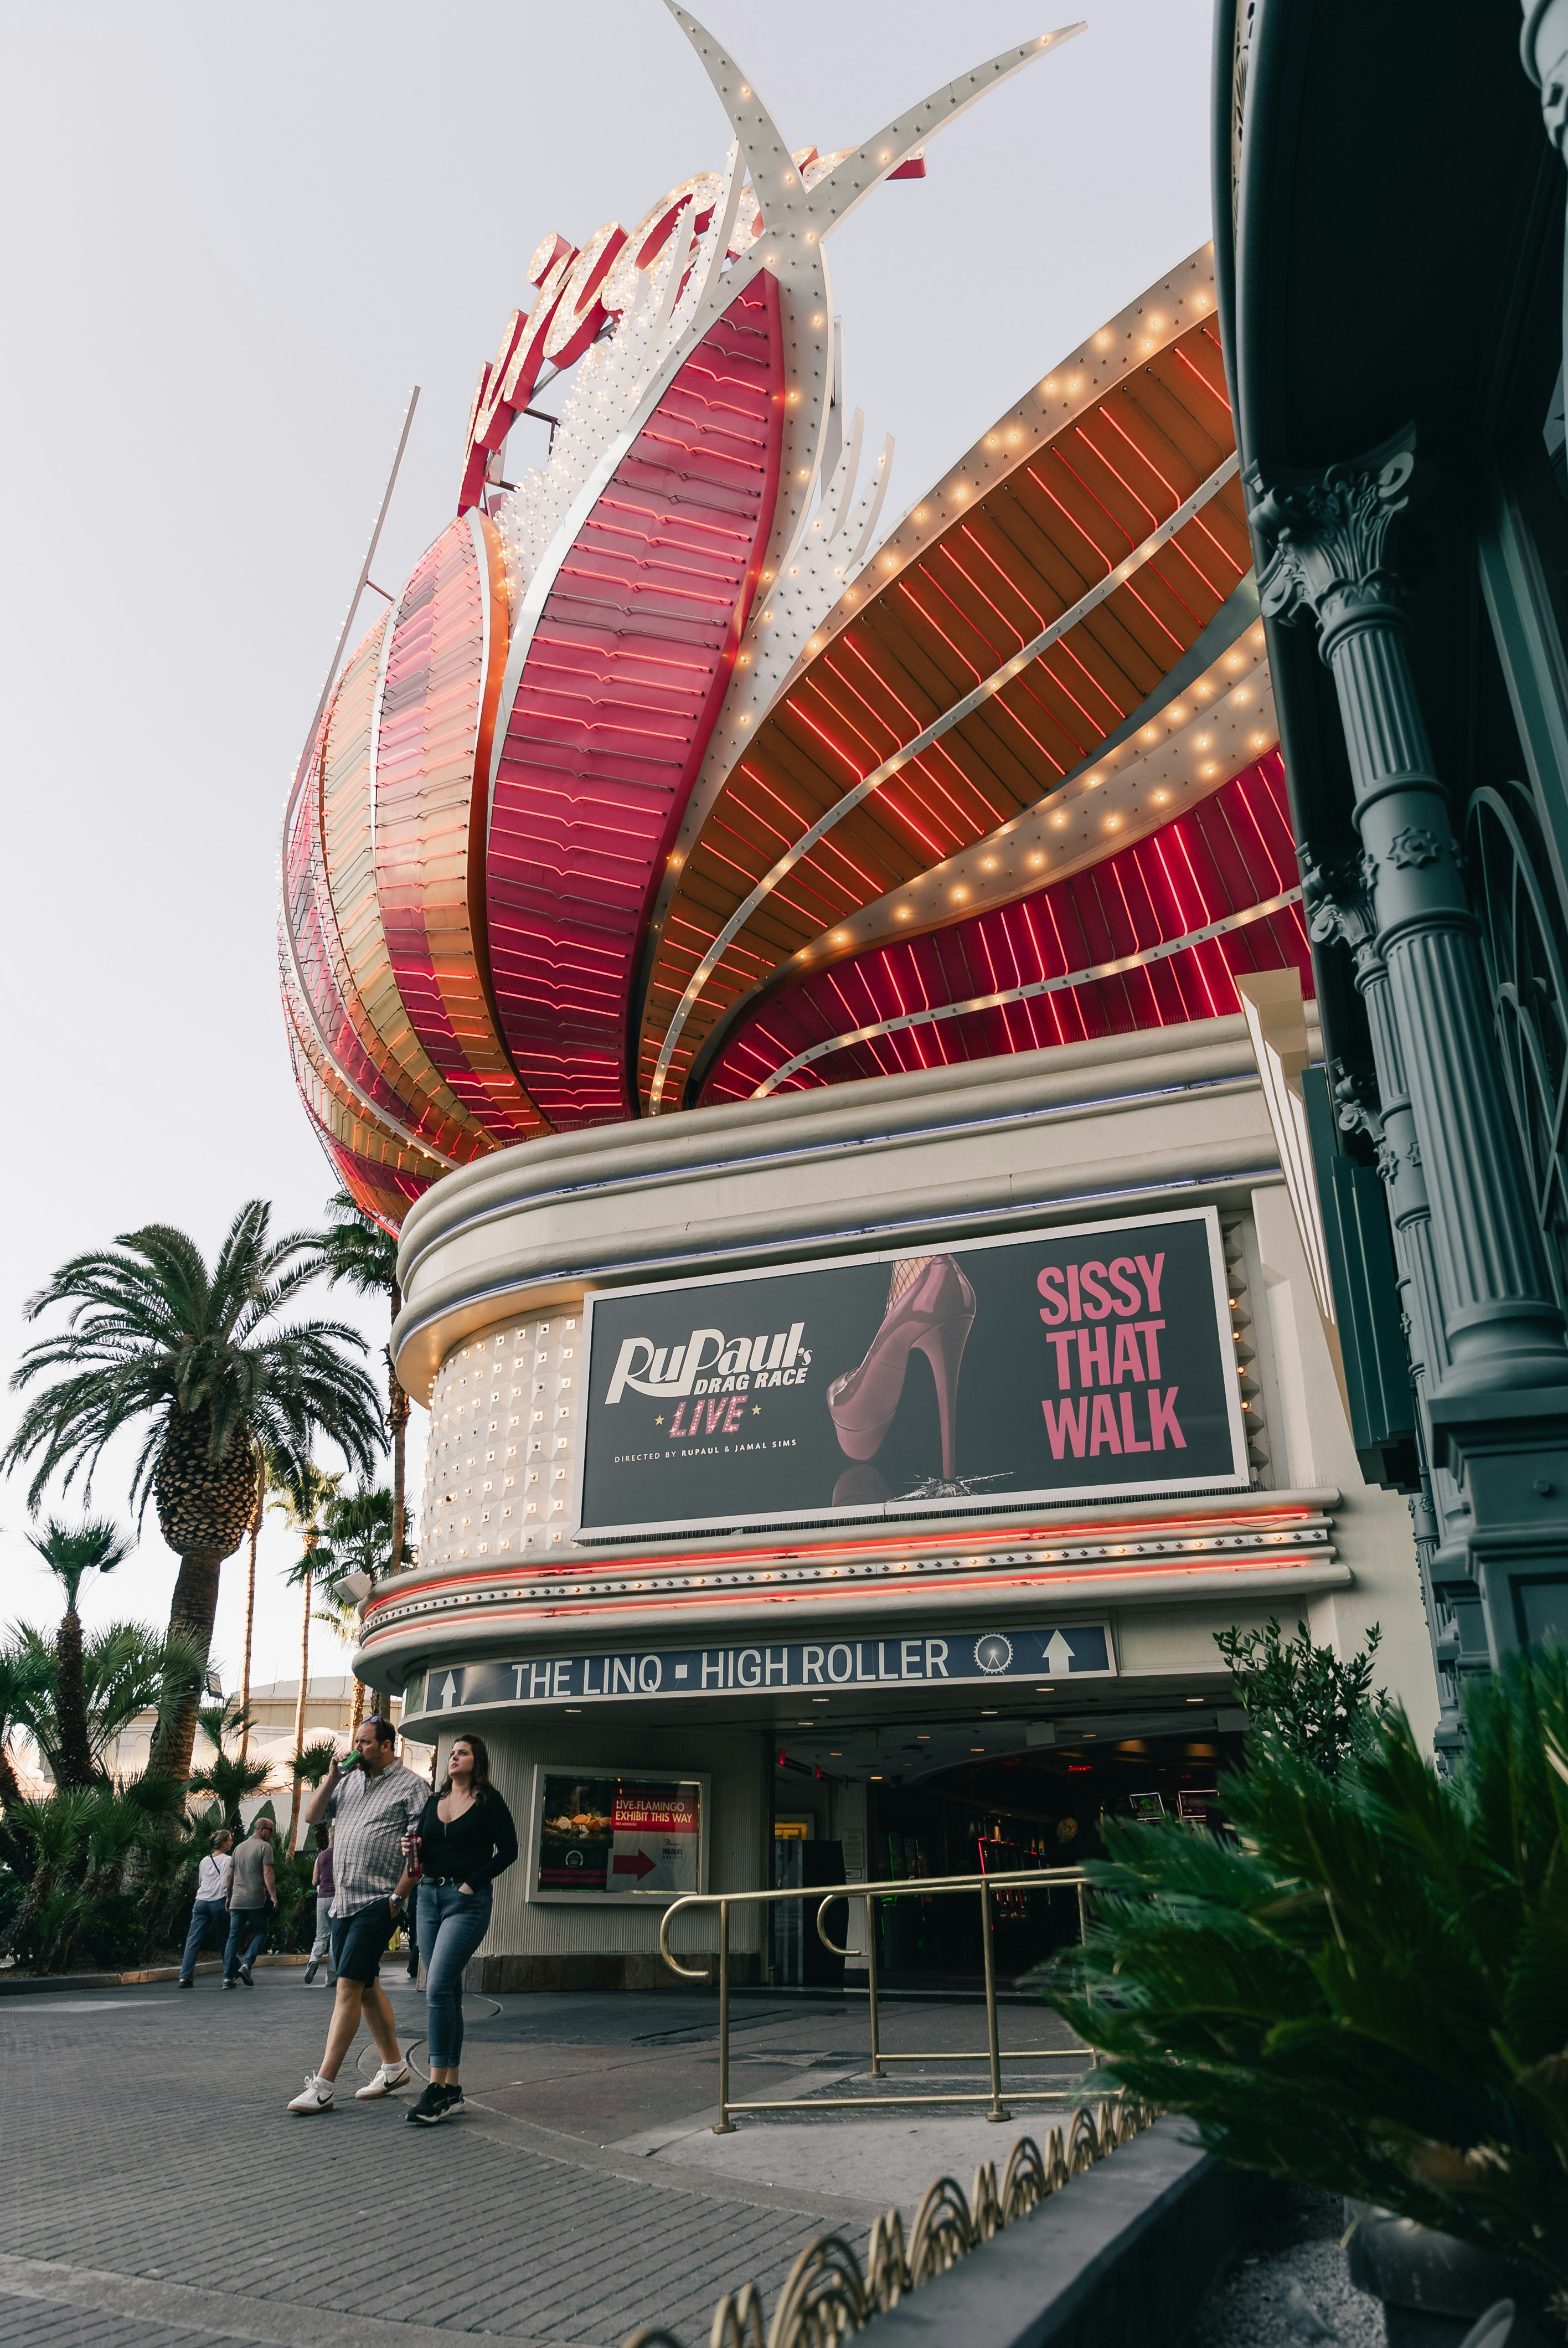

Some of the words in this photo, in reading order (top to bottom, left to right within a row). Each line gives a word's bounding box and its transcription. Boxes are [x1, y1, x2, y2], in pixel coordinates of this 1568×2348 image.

[1037, 1253, 1165, 1325] SISSY
[605, 1322, 813, 1404] RuPaul's
[1046, 1319, 1165, 1391] THAT
[693, 1374, 749, 1396] DRAG
[754, 1367, 808, 1389] RACE
[669, 1395, 748, 1438] LIVE
[1041, 1386, 1187, 1460] WALK
[614, 1452, 661, 1463] DIRECTED
[681, 1446, 720, 1456] RUPAUL
[734, 1442, 767, 1452] JAMAL
[772, 1439, 797, 1448] SIMS
[512, 1660, 572, 1699] THE
[583, 1655, 662, 1695] LINQ
[700, 1647, 788, 1688] HIGH
[802, 1639, 949, 1683] ROLLER
[615, 1811, 648, 1821] EXHIBIT
[651, 1813, 670, 1822] THIS
[672, 1813, 693, 1823] WAY
[637, 1801, 685, 1812] FLAMINGO
